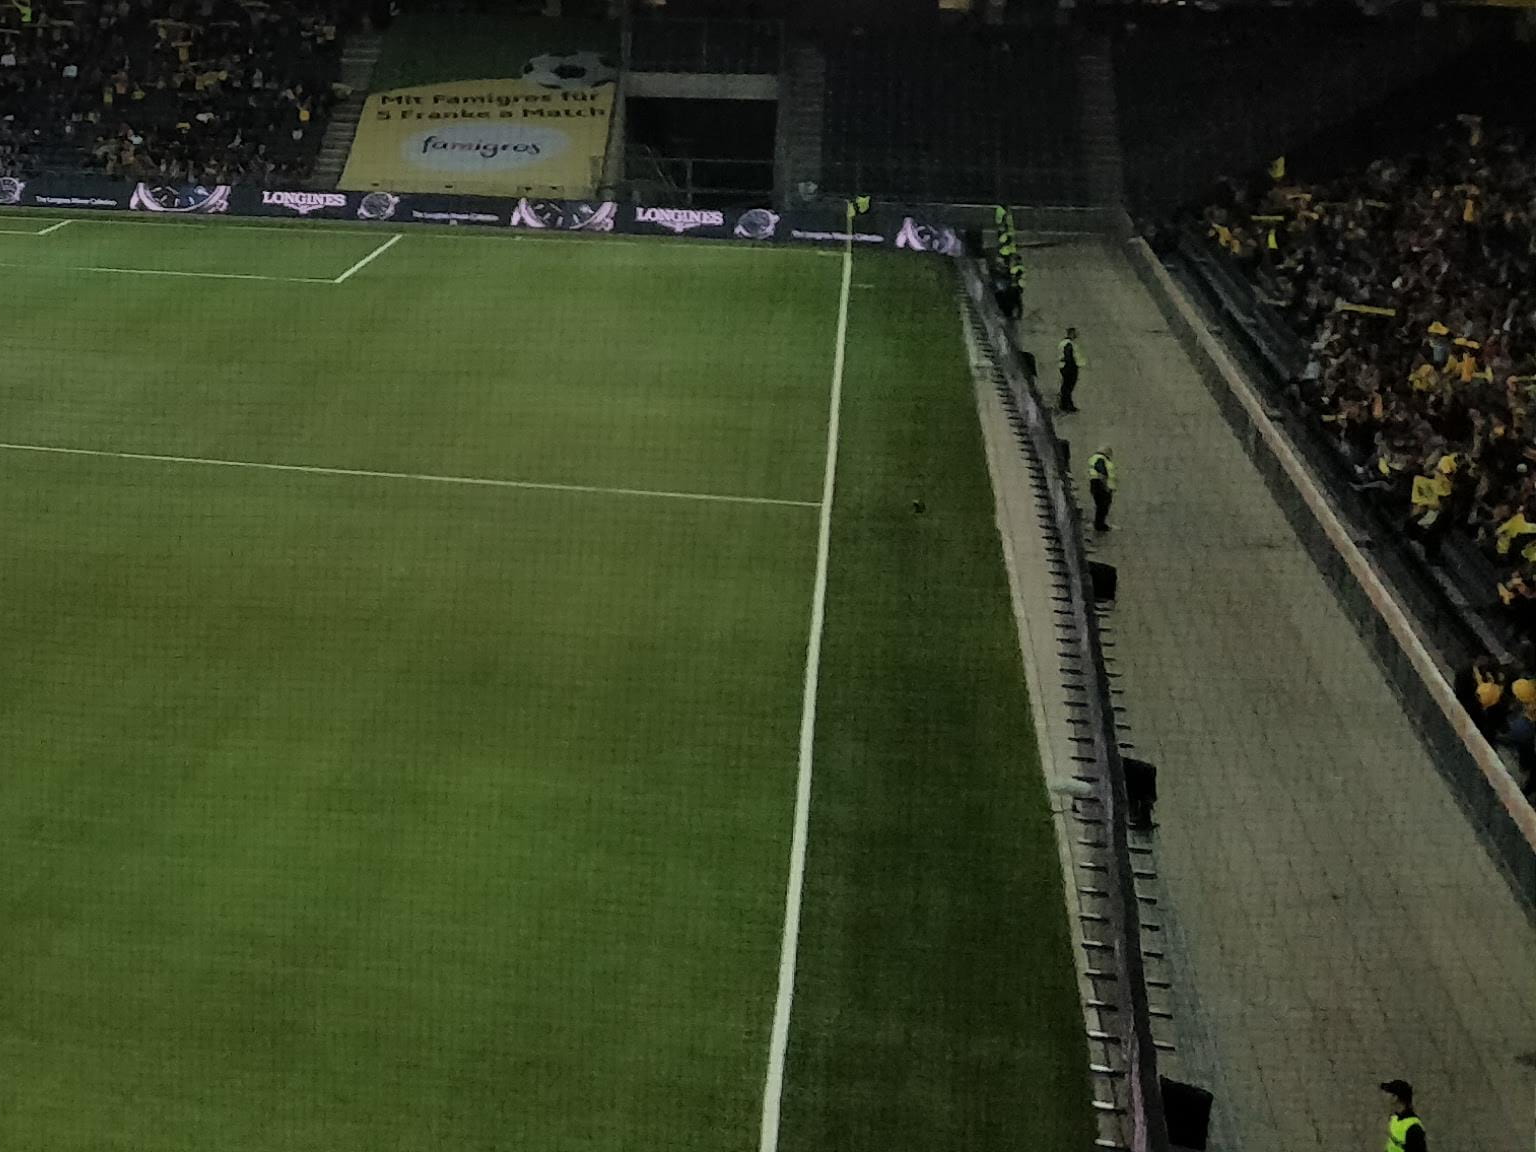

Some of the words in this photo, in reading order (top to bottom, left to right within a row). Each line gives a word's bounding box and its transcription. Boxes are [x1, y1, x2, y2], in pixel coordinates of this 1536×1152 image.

[381, 95, 424, 106] Mit
[432, 94, 553, 107] Famigros
[560, 91, 600, 102] für
[522, 107, 606, 119] Match
[421, 135, 541, 158] famigros
[262, 190, 347, 208] LONGINES
[635, 206, 726, 226] LONGINES
